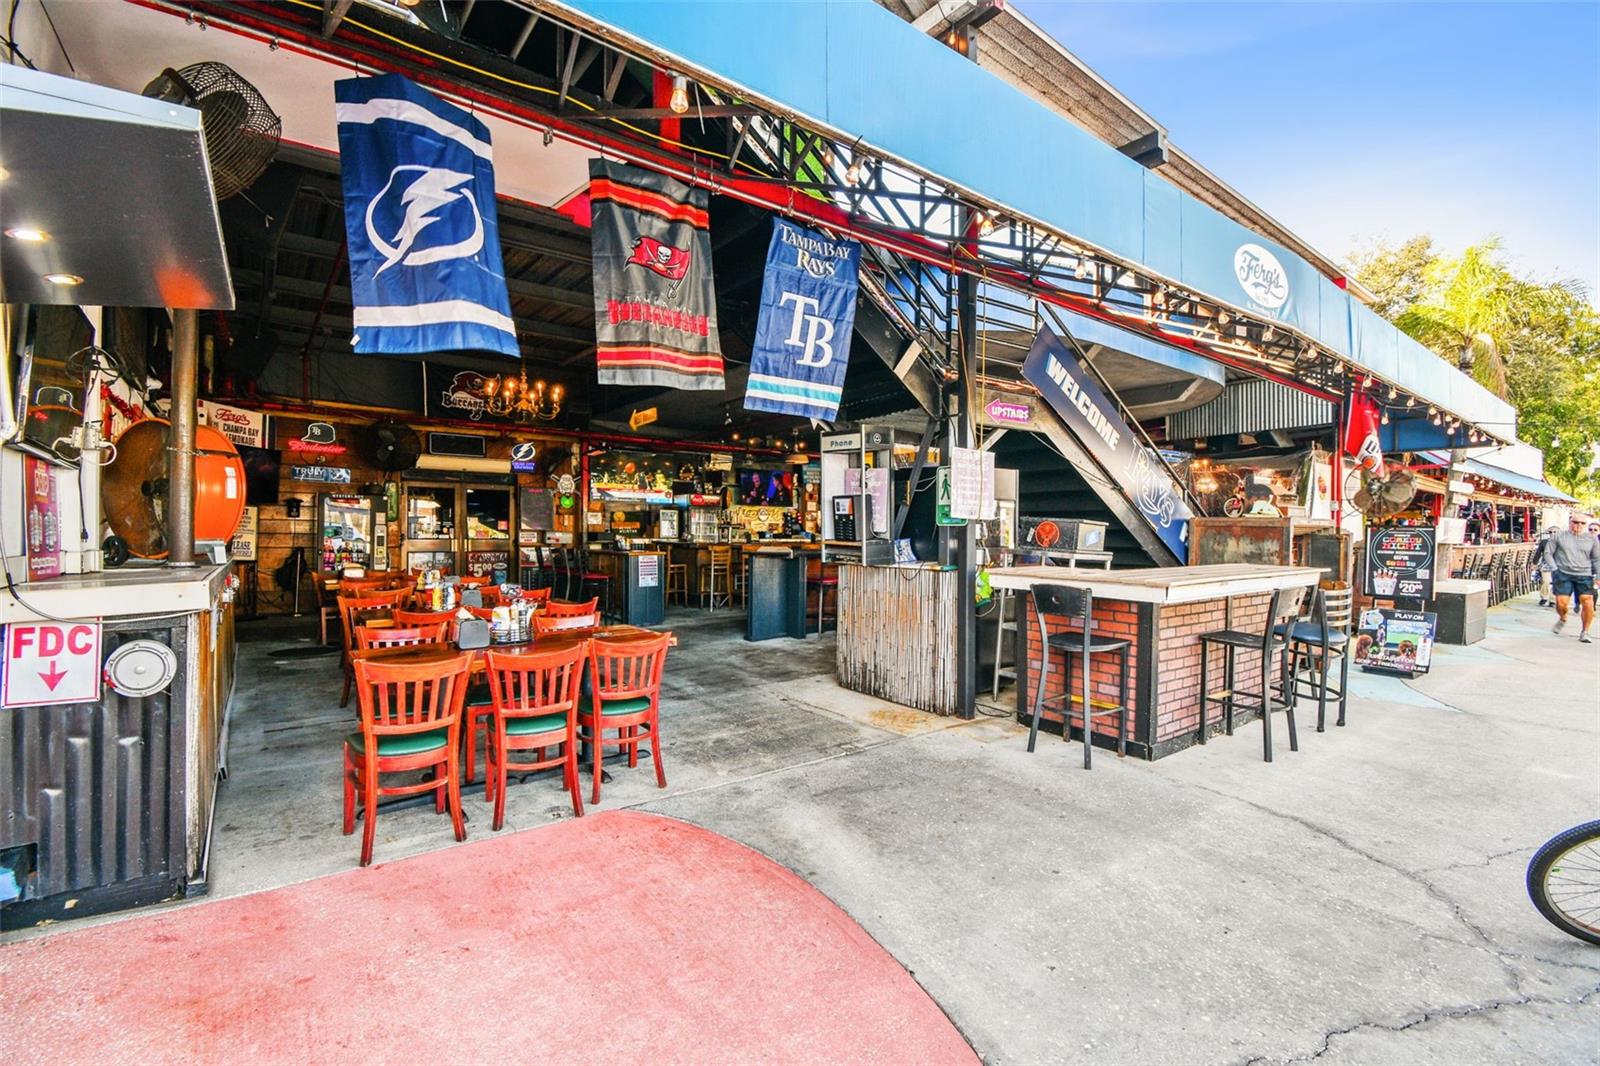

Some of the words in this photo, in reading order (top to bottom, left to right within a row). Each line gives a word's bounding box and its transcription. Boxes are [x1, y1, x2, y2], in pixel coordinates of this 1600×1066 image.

[779, 291, 835, 368] TB
[991, 406, 1029, 419] UPSTAIRS
[1045, 352, 1121, 452] WELCOME
[223, 423, 247, 436] CHAMPA
[247, 428, 259, 437] BAY
[1394, 612, 1412, 620] PLAY
[13, 625, 93, 659] FDC
